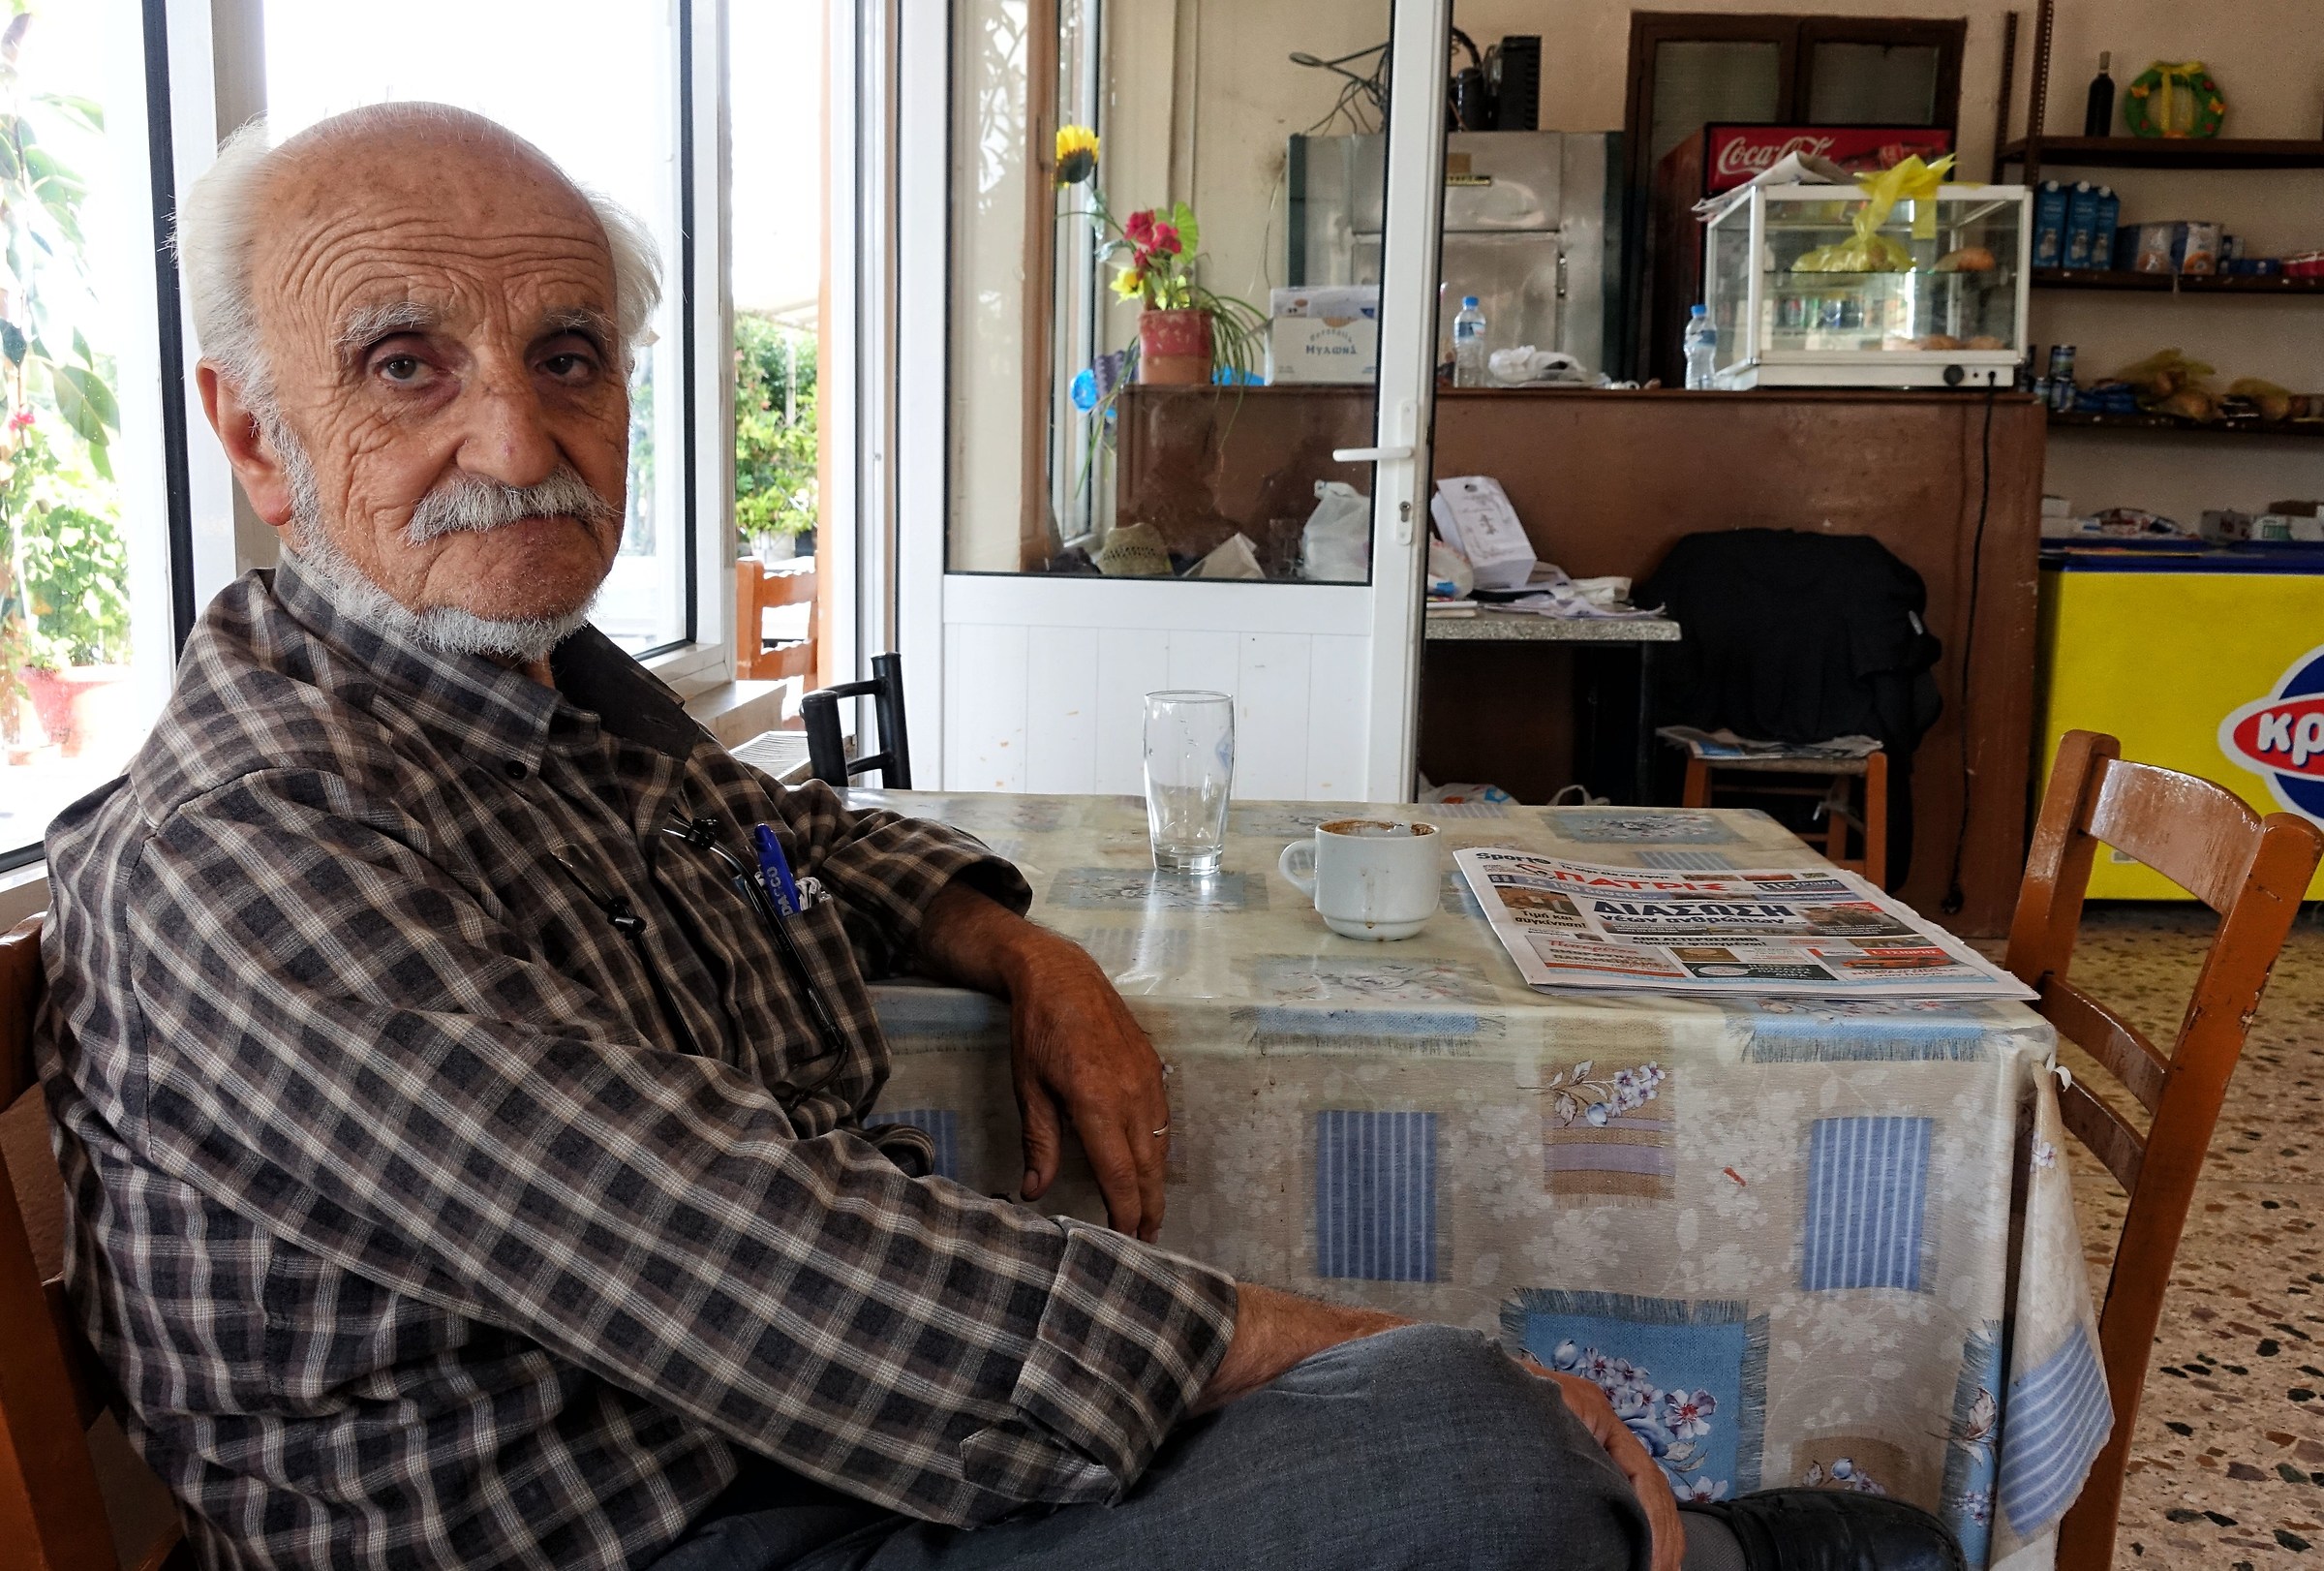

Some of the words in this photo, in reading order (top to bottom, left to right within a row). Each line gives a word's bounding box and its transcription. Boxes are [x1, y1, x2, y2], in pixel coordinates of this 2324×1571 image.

[1553, 870, 1730, 891] ΠΑΤΡΙΣ
[1594, 901, 1796, 917] ΔΙΑΣΩΣΗ
[1599, 914, 1658, 923] νέων
